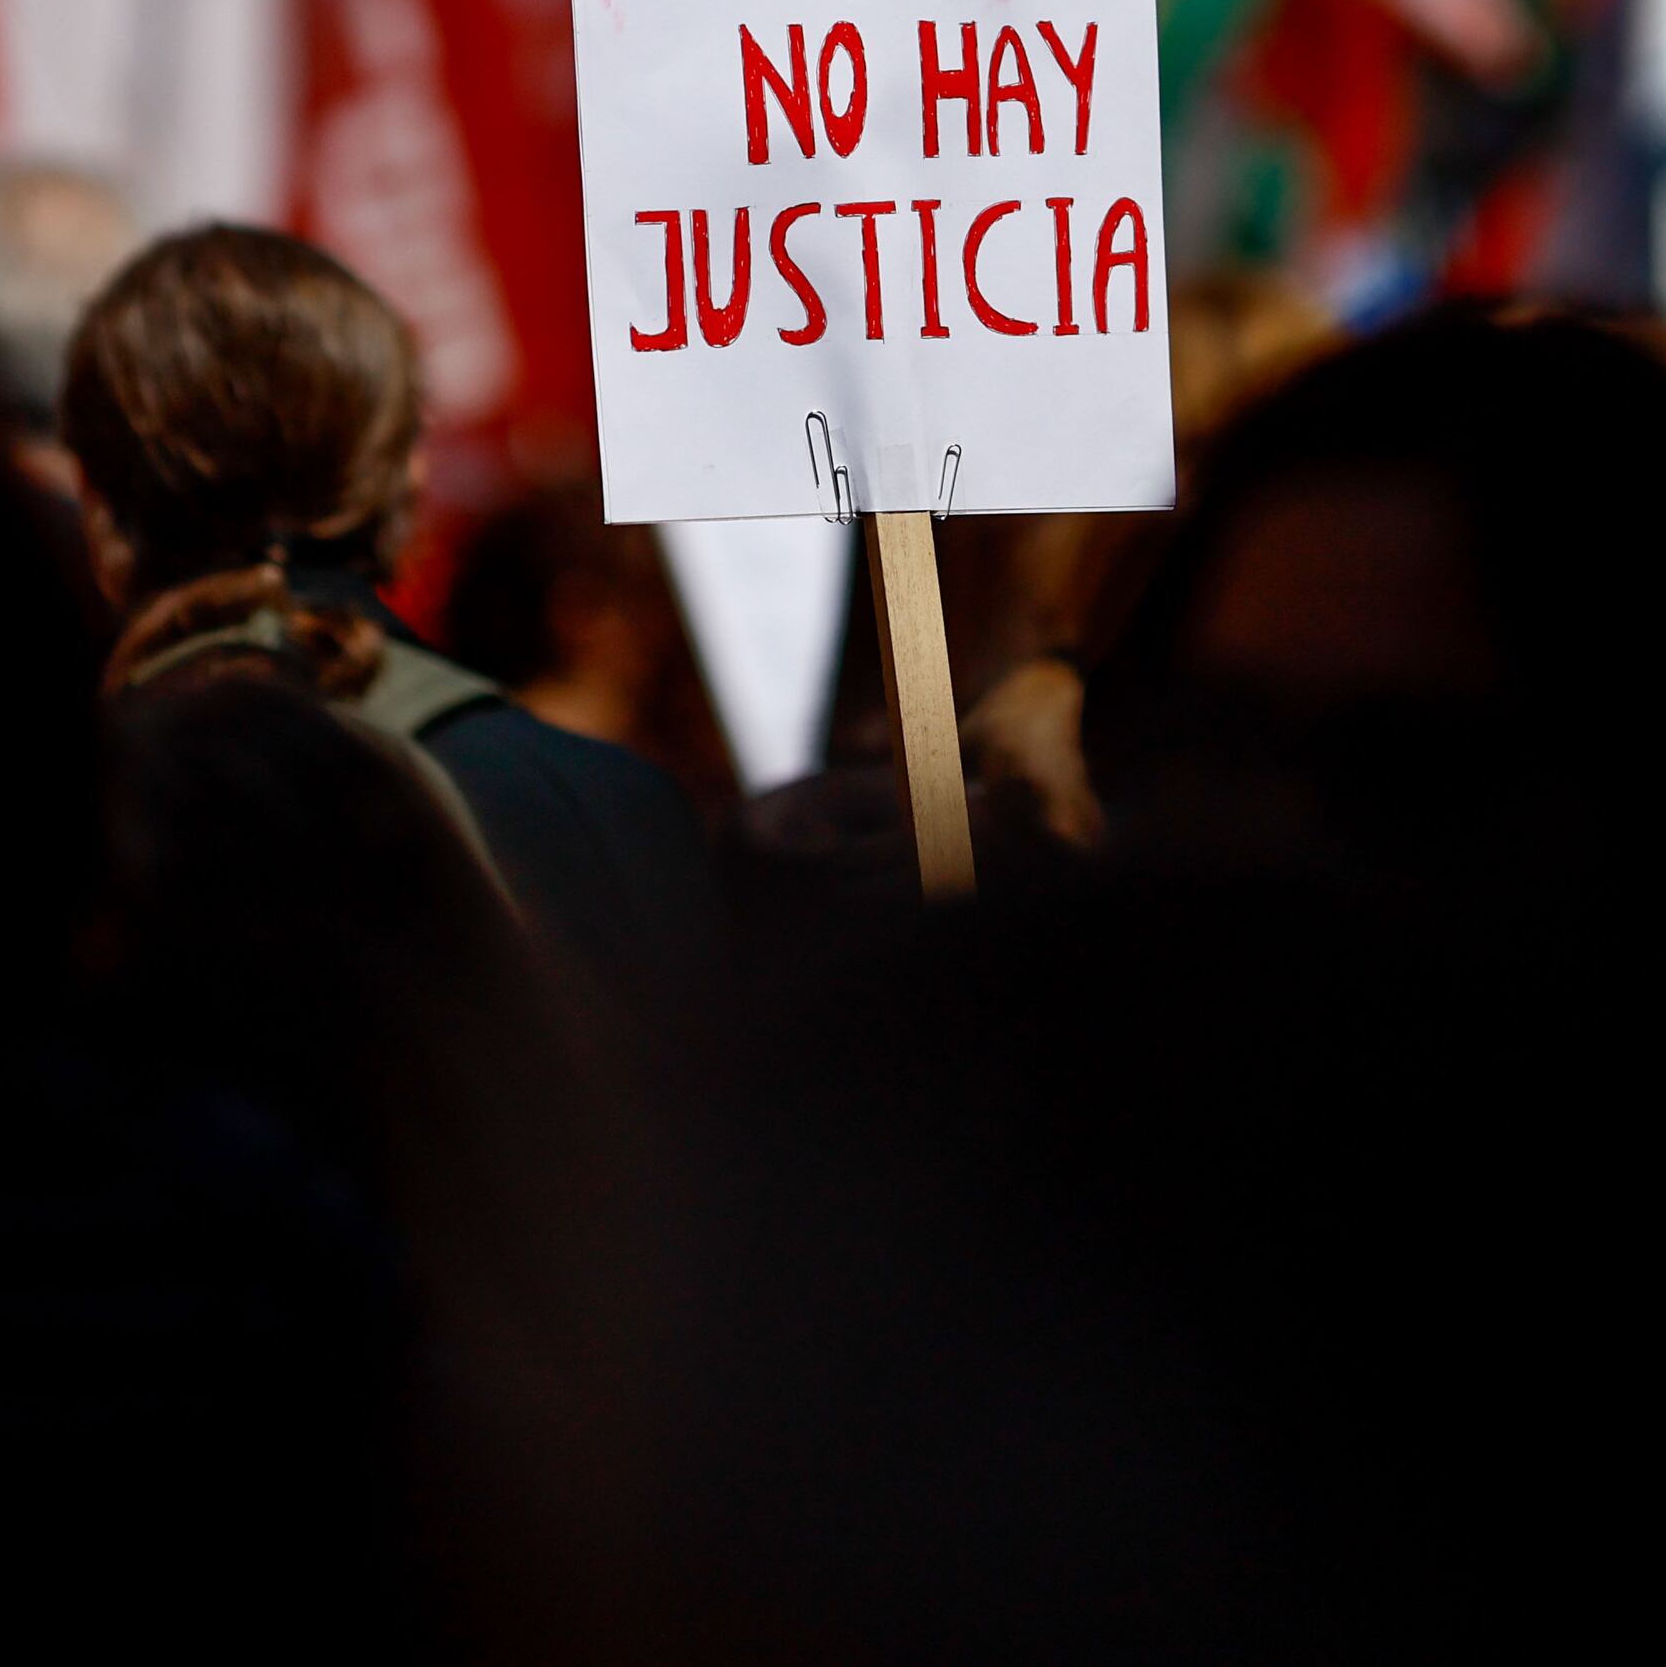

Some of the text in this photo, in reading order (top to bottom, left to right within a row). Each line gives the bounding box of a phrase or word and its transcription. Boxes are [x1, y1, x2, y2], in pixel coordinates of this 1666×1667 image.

[738, 19, 1099, 166] NO HAY
[628, 196, 1151, 354] JUSTICIA
